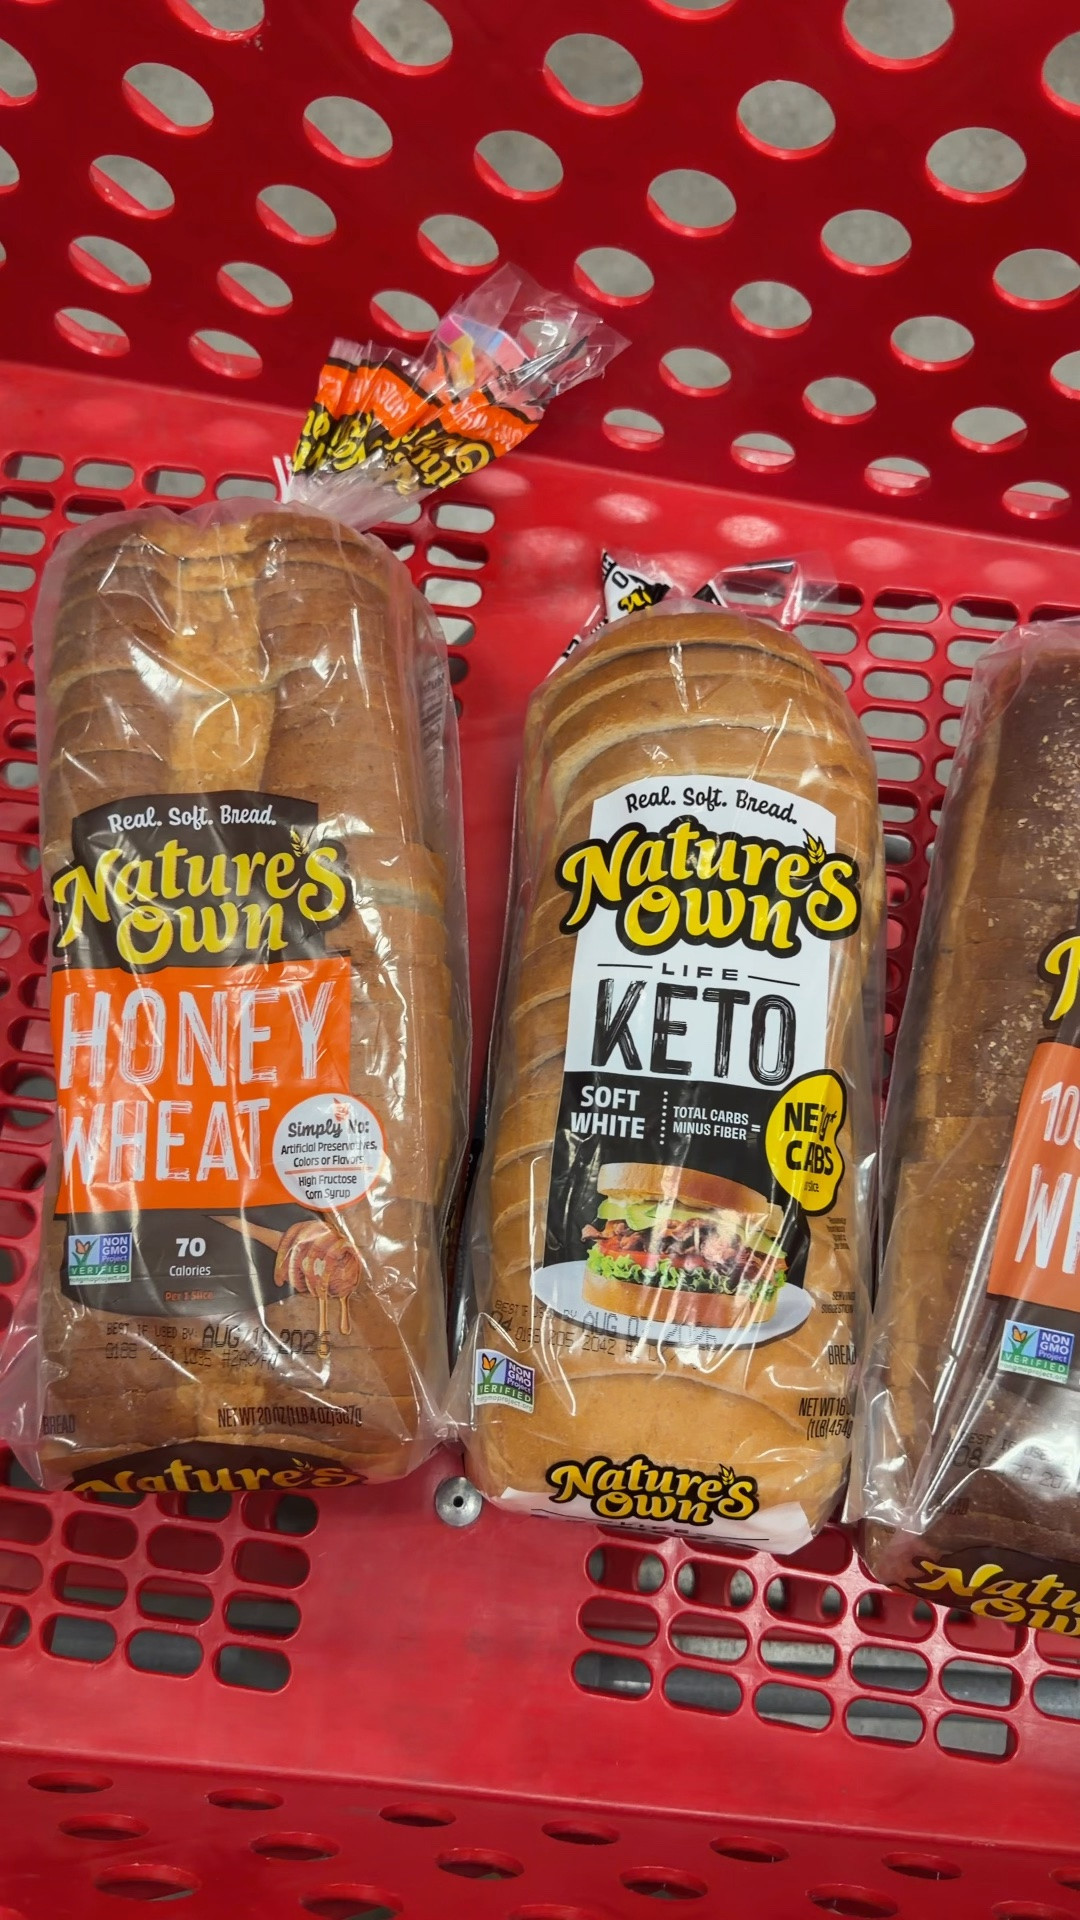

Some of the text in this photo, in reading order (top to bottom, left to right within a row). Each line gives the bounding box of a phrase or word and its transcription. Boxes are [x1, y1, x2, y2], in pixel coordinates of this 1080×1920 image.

[625, 785, 797, 824] Real. Soft. Bread.
[107, 805, 277, 834] Real. Soft. Bread.
[624, 884, 794, 950] Own
[116, 901, 289, 965] Own
[661, 962, 739, 981] LIFE
[59, 981, 338, 1089] HONEY
[591, 978, 797, 1086] KETO
[580, 1085, 641, 1111] SOFT
[570, 1111, 646, 1140] WHITE
[673, 1105, 749, 1126] TOTAL CARBS
[1041, 1081, 1080, 1150] 10
[288, 1119, 343, 1139] Simply
[672, 1121, 747, 1141] MINUS FIBER
[58, 1098, 271, 1185] WHEAT
[281, 1142, 316, 1155] Artificial
[293, 1156, 319, 1168] Colors
[321, 1156, 331, 1165] or
[298, 1174, 357, 1187] High Fructose
[324, 1188, 351, 1199] Syrup
[102, 1236, 128, 1247] NON
[102, 1246, 128, 1256] GMO
[175, 1237, 207, 1257] 70
[71, 1264, 128, 1275] VERIFIED
[102, 1255, 128, 1264] Project
[169, 1265, 211, 1277] Calories
[202, 1324, 240, 1349] AUG
[1041, 1332, 1070, 1347] NON
[827, 1345, 857, 1365] BREAD
[1038, 1349, 1067, 1363] Project
[1040, 1341, 1069, 1355] GMO
[508, 1361, 531, 1379] NON
[1004, 1352, 1066, 1373] VERIFIED
[508, 1370, 532, 1388] GMO
[799, 1398, 818, 1416] NET
[819, 1398, 836, 1416] WT
[596, 1491, 709, 1523] Own
